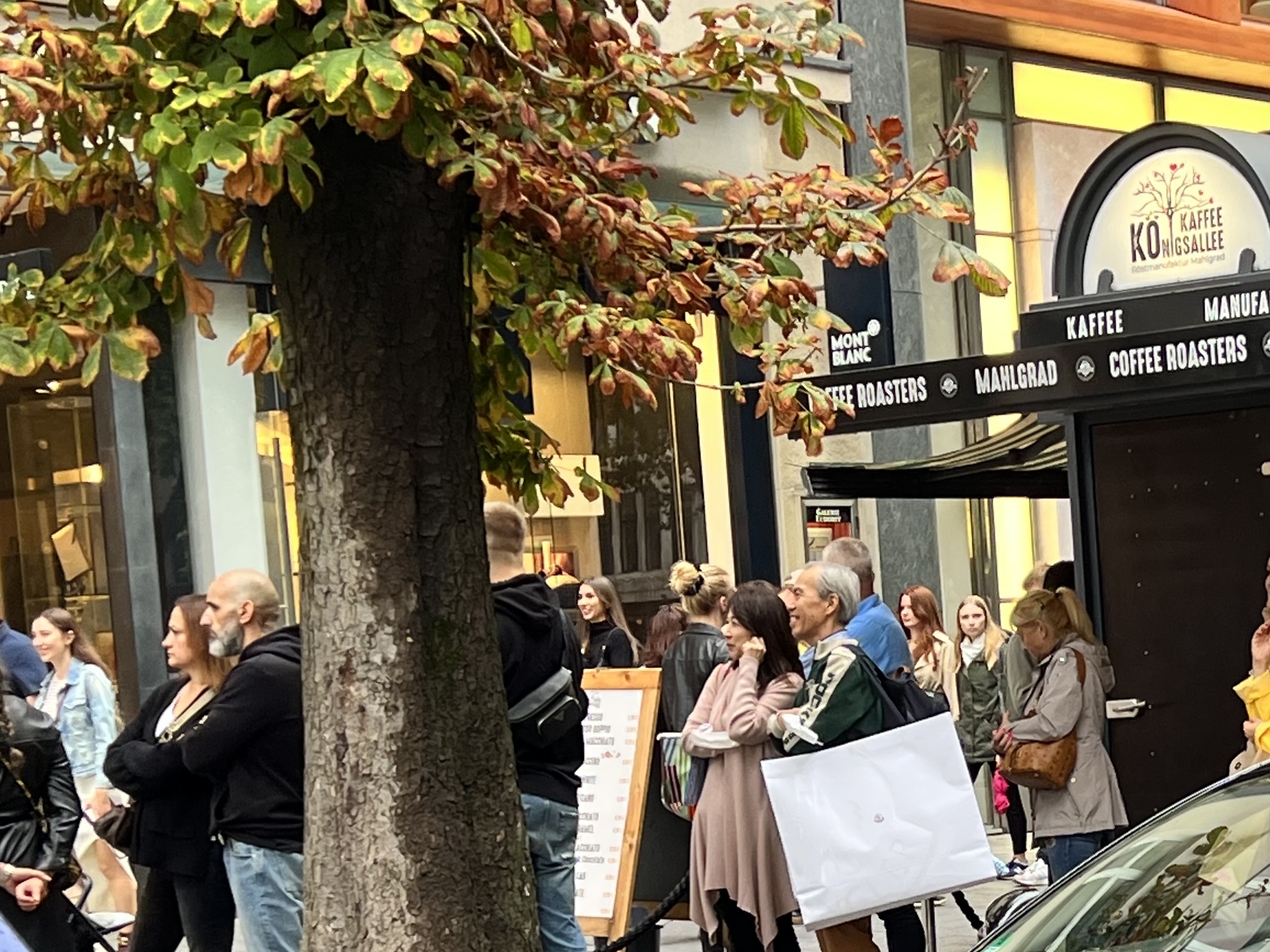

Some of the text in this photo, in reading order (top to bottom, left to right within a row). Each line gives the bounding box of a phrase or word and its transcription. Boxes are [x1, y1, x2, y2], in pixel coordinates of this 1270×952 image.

[1180, 207, 1222, 232] KAFFEE
[1066, 309, 1124, 340] KAFFEE
[830, 331, 869, 350] MONT
[832, 346, 872, 366] BLANC
[857, 376, 928, 409] ROASTERS
[975, 359, 1058, 394] MAHLGRAD
[1109, 344, 1162, 379] COFFEE
[1165, 333, 1248, 373] ROASTERS
